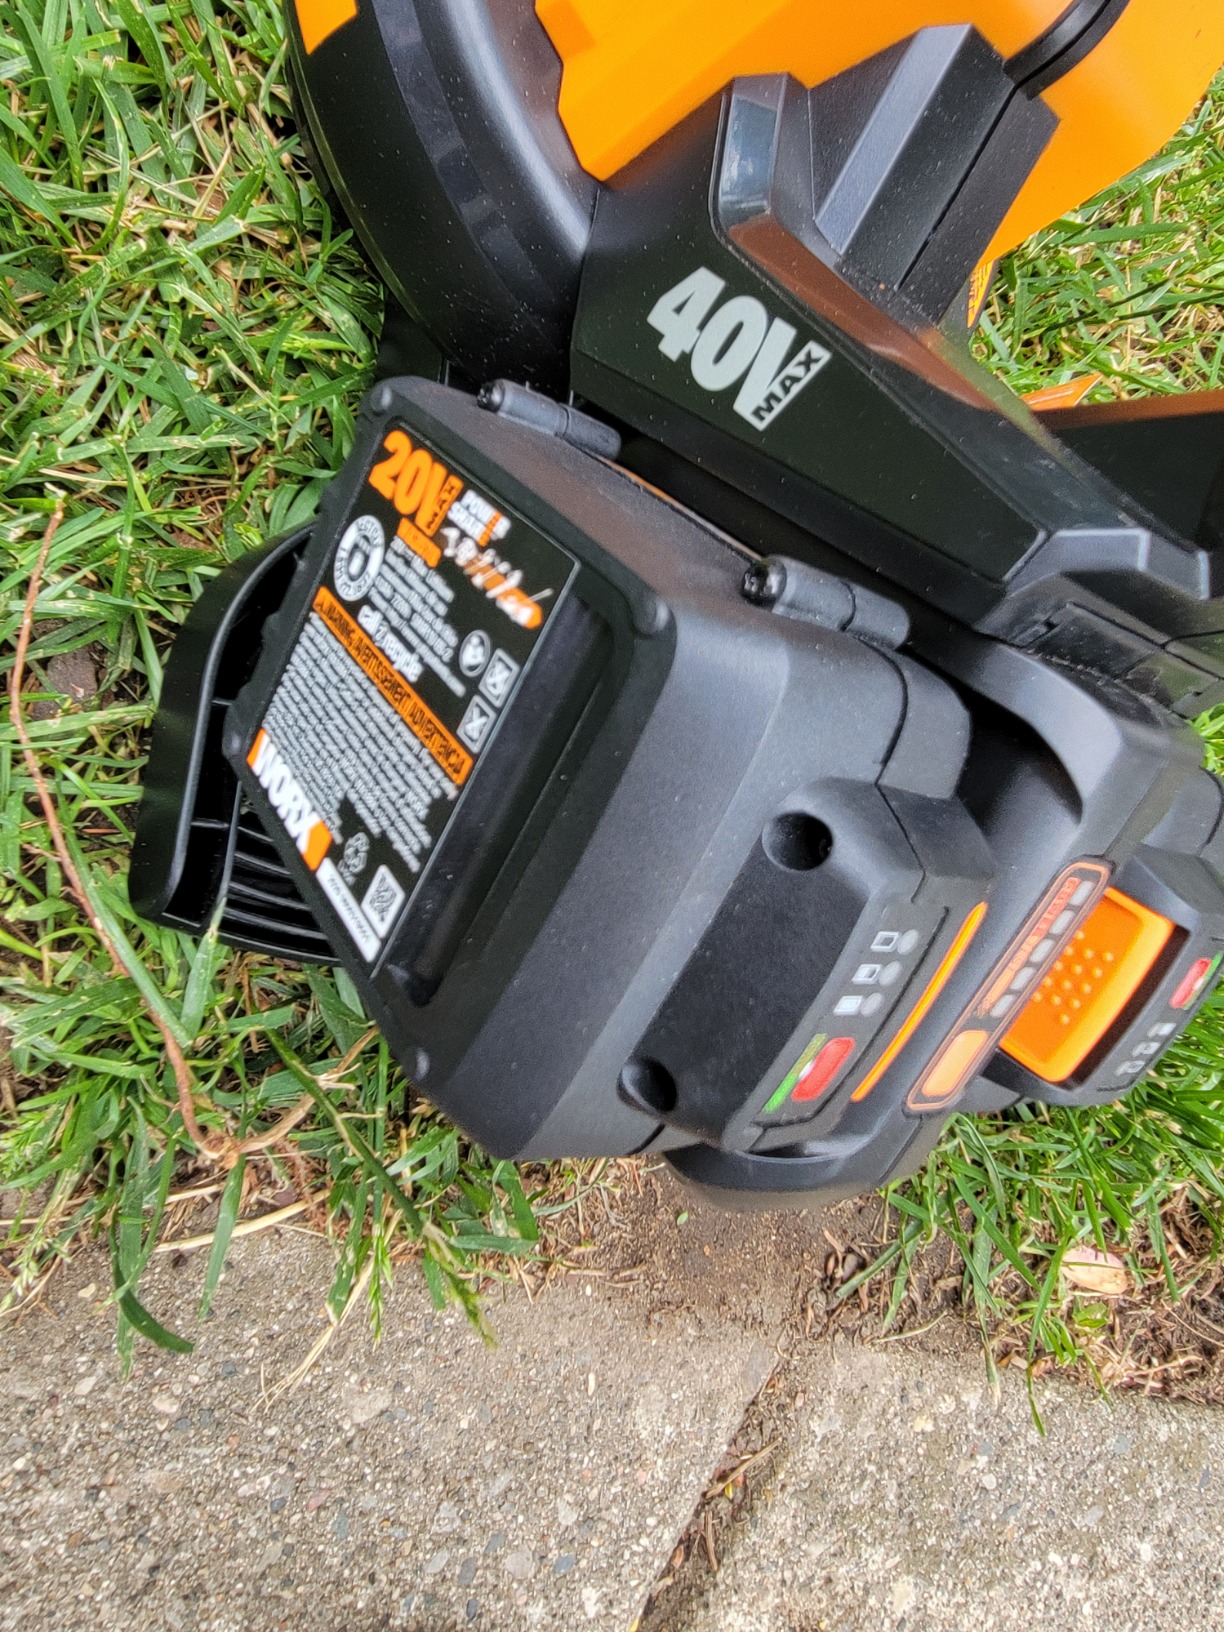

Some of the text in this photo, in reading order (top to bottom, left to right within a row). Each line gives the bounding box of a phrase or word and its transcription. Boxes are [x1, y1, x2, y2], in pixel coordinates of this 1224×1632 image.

[647, 266, 816, 431] 40V
[751, 349, 823, 422] MAX
[368, 430, 460, 537] 20V
[426, 485, 456, 530] MAX
[251, 734, 322, 854] WORX
